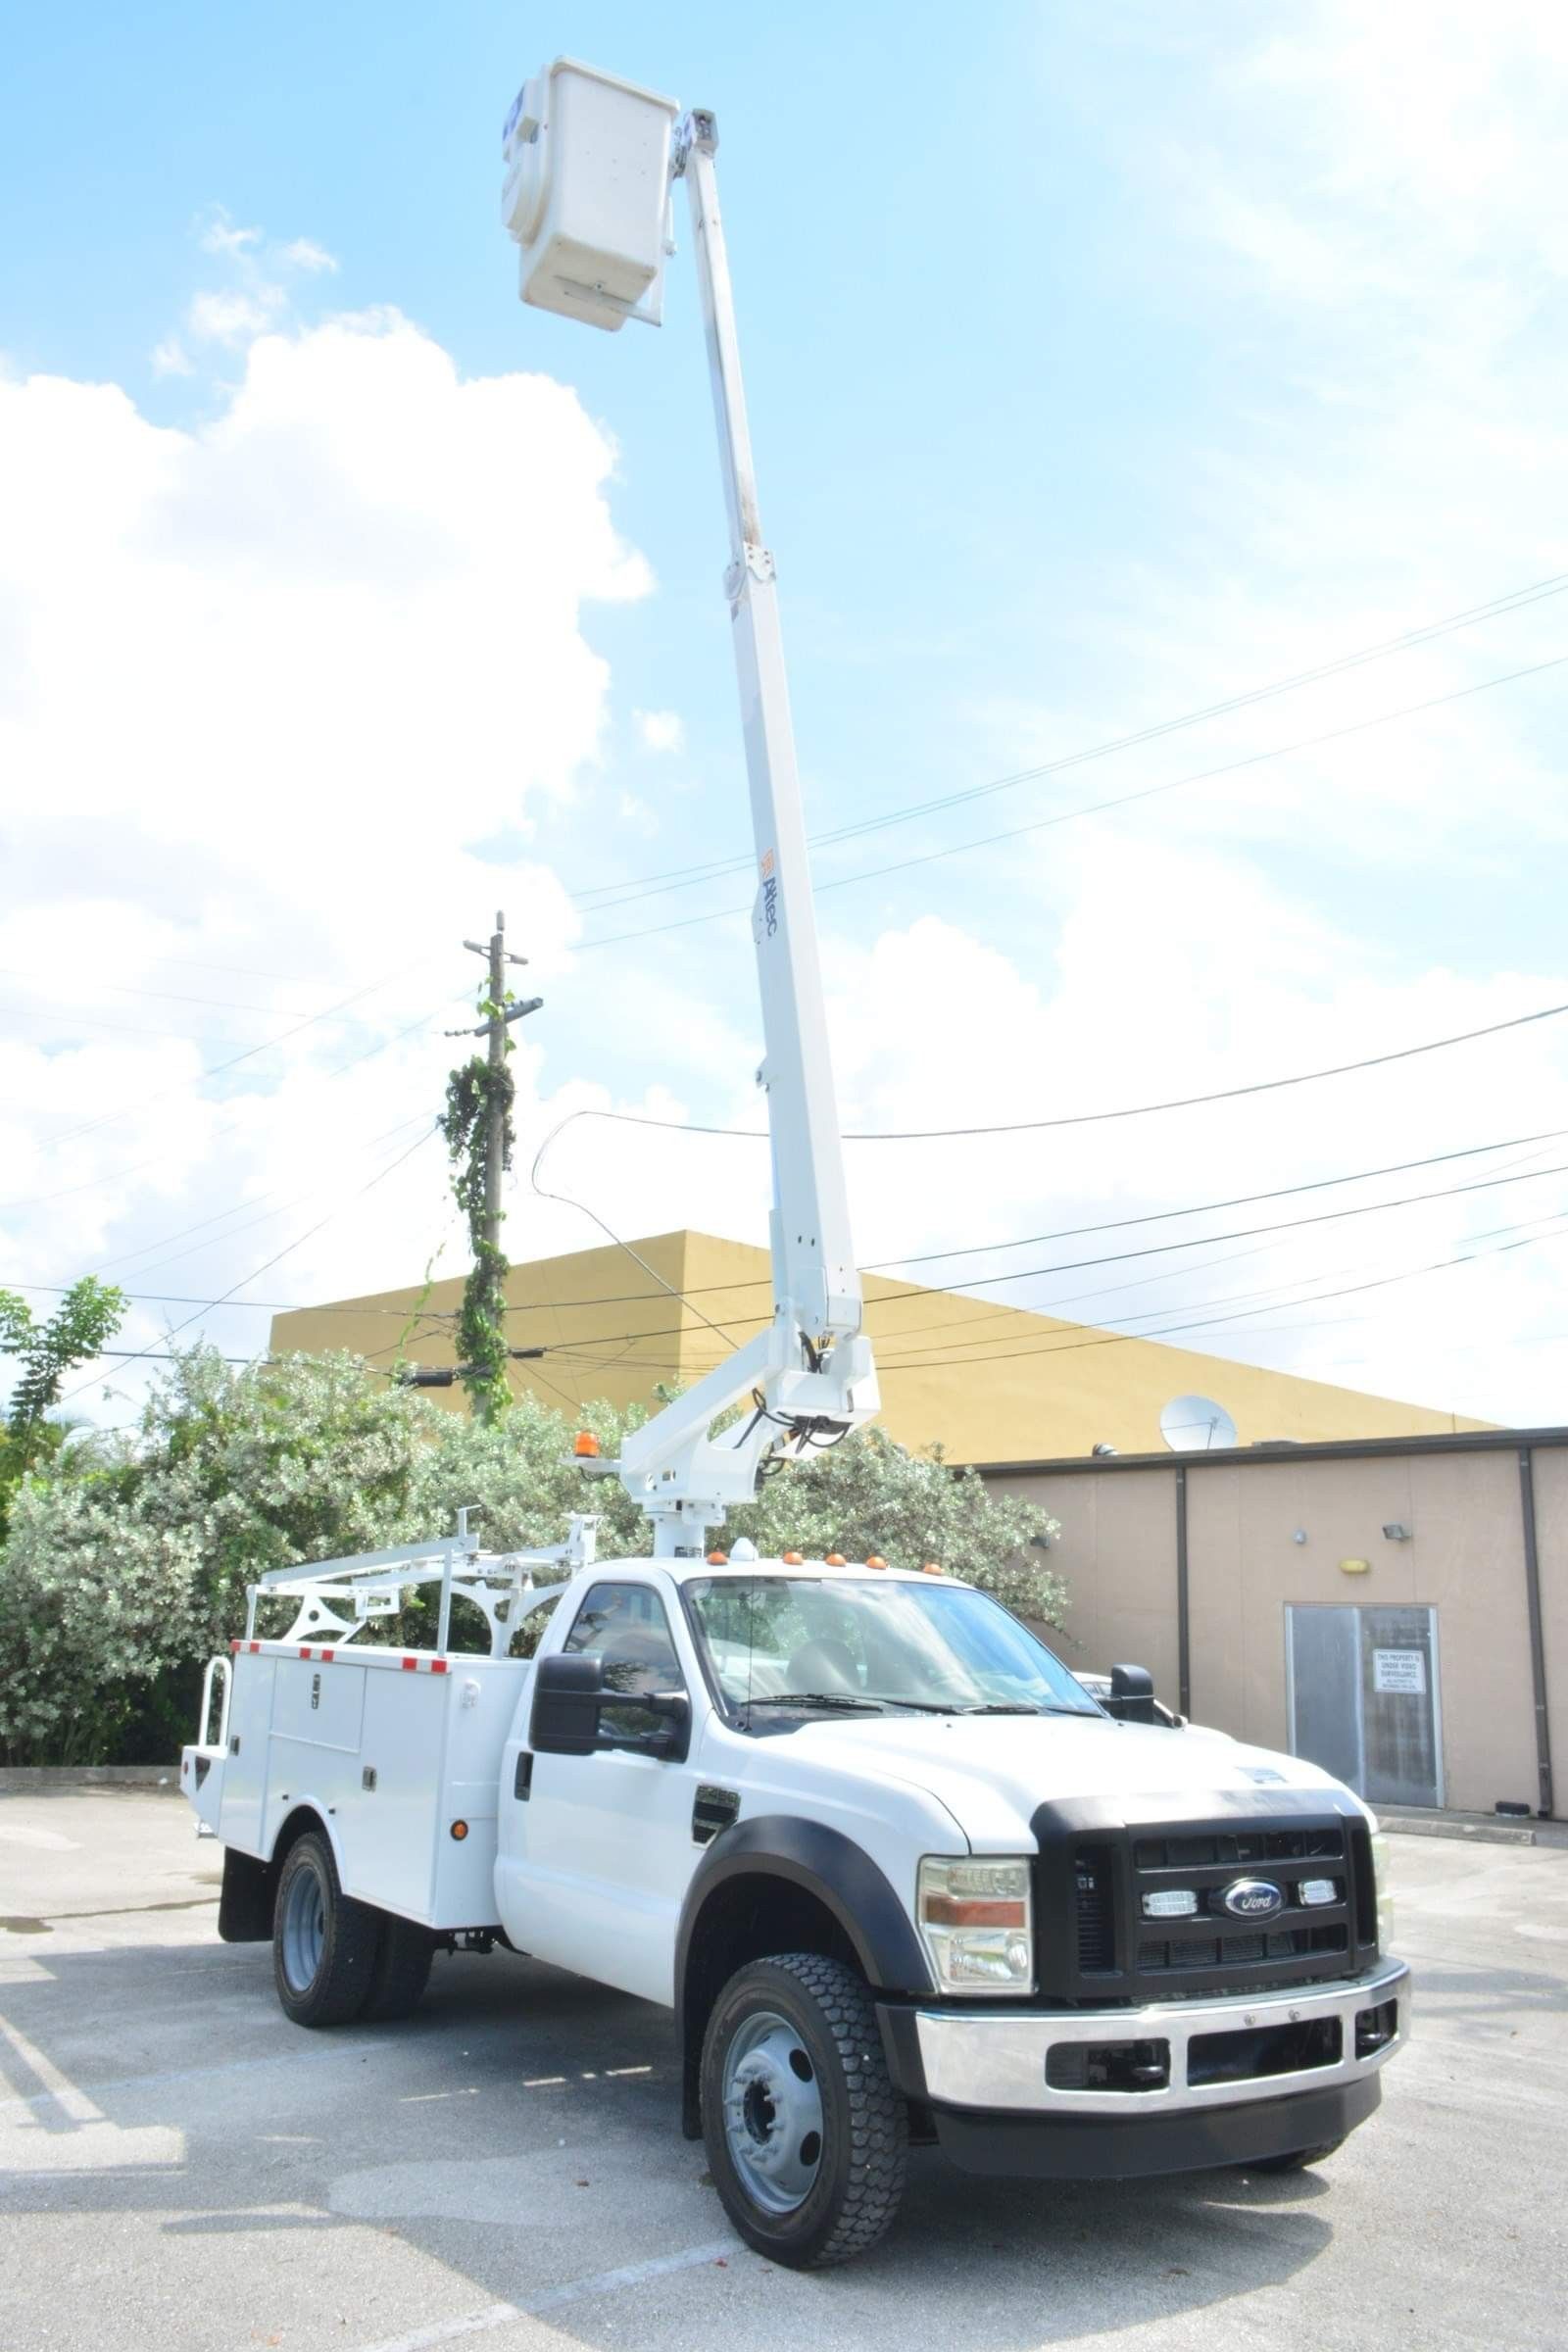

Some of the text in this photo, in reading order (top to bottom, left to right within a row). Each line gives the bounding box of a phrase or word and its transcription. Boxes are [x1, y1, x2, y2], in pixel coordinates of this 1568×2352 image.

[762, 876, 778, 937] Altec
[1390, 1653, 1413, 1662] PROPERTY
[1242, 1892, 1272, 1910] Ford
